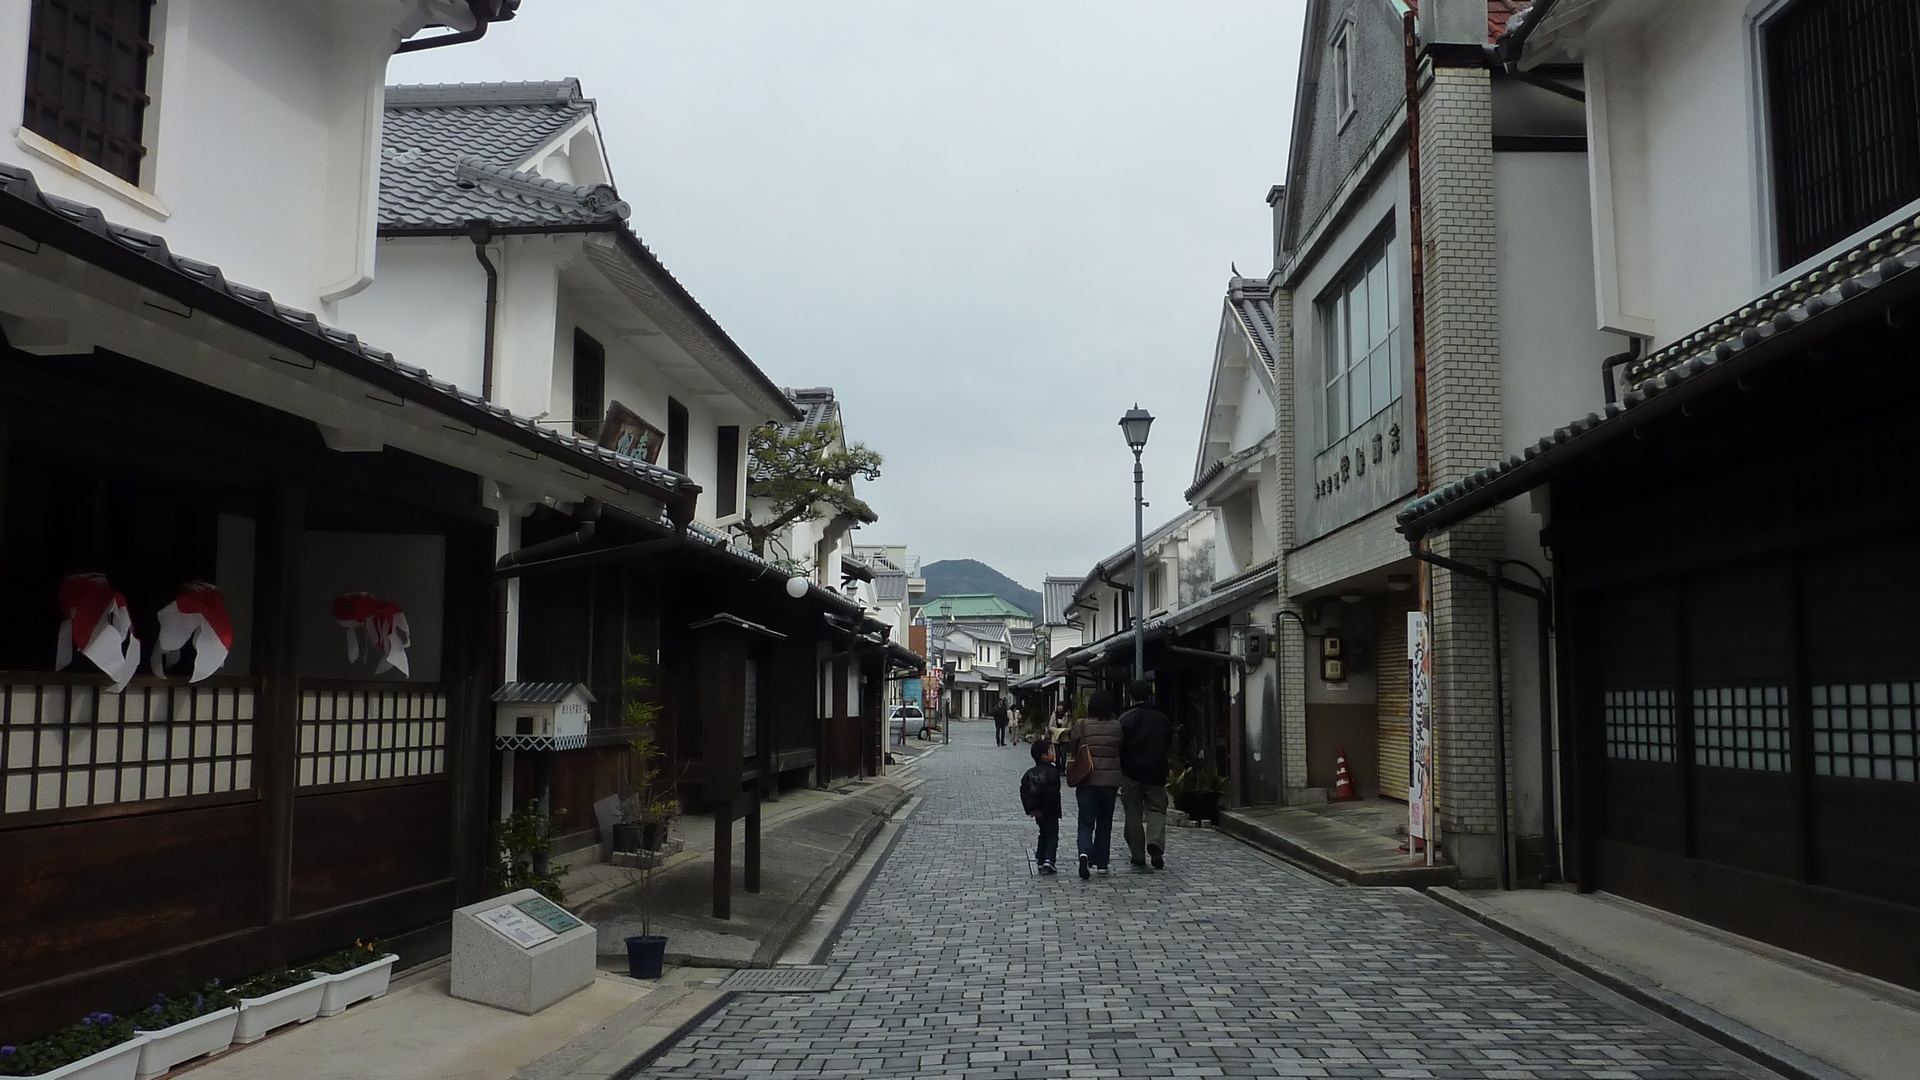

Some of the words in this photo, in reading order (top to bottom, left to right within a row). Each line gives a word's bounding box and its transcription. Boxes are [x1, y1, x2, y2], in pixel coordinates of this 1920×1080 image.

[1414, 641, 1427, 800] おひなさま巡り
